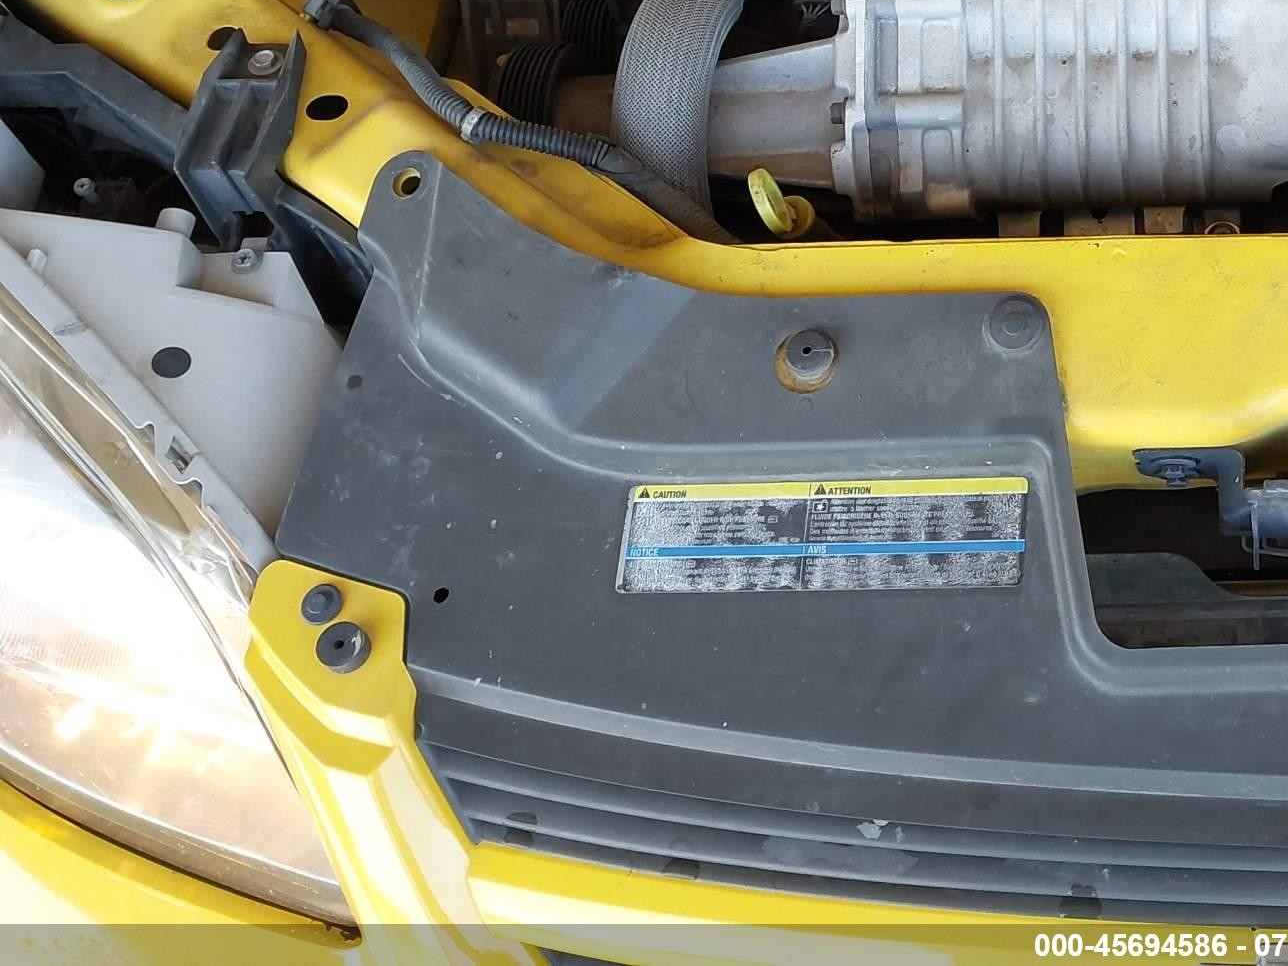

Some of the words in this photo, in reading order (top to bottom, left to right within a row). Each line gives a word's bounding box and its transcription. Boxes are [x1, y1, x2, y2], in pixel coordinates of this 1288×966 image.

[652, 490, 687, 499] CAUTION
[828, 486, 872, 495] ATTENTION
[629, 546, 660, 557] NOTICE
[807, 545, 826, 554] AVIS
